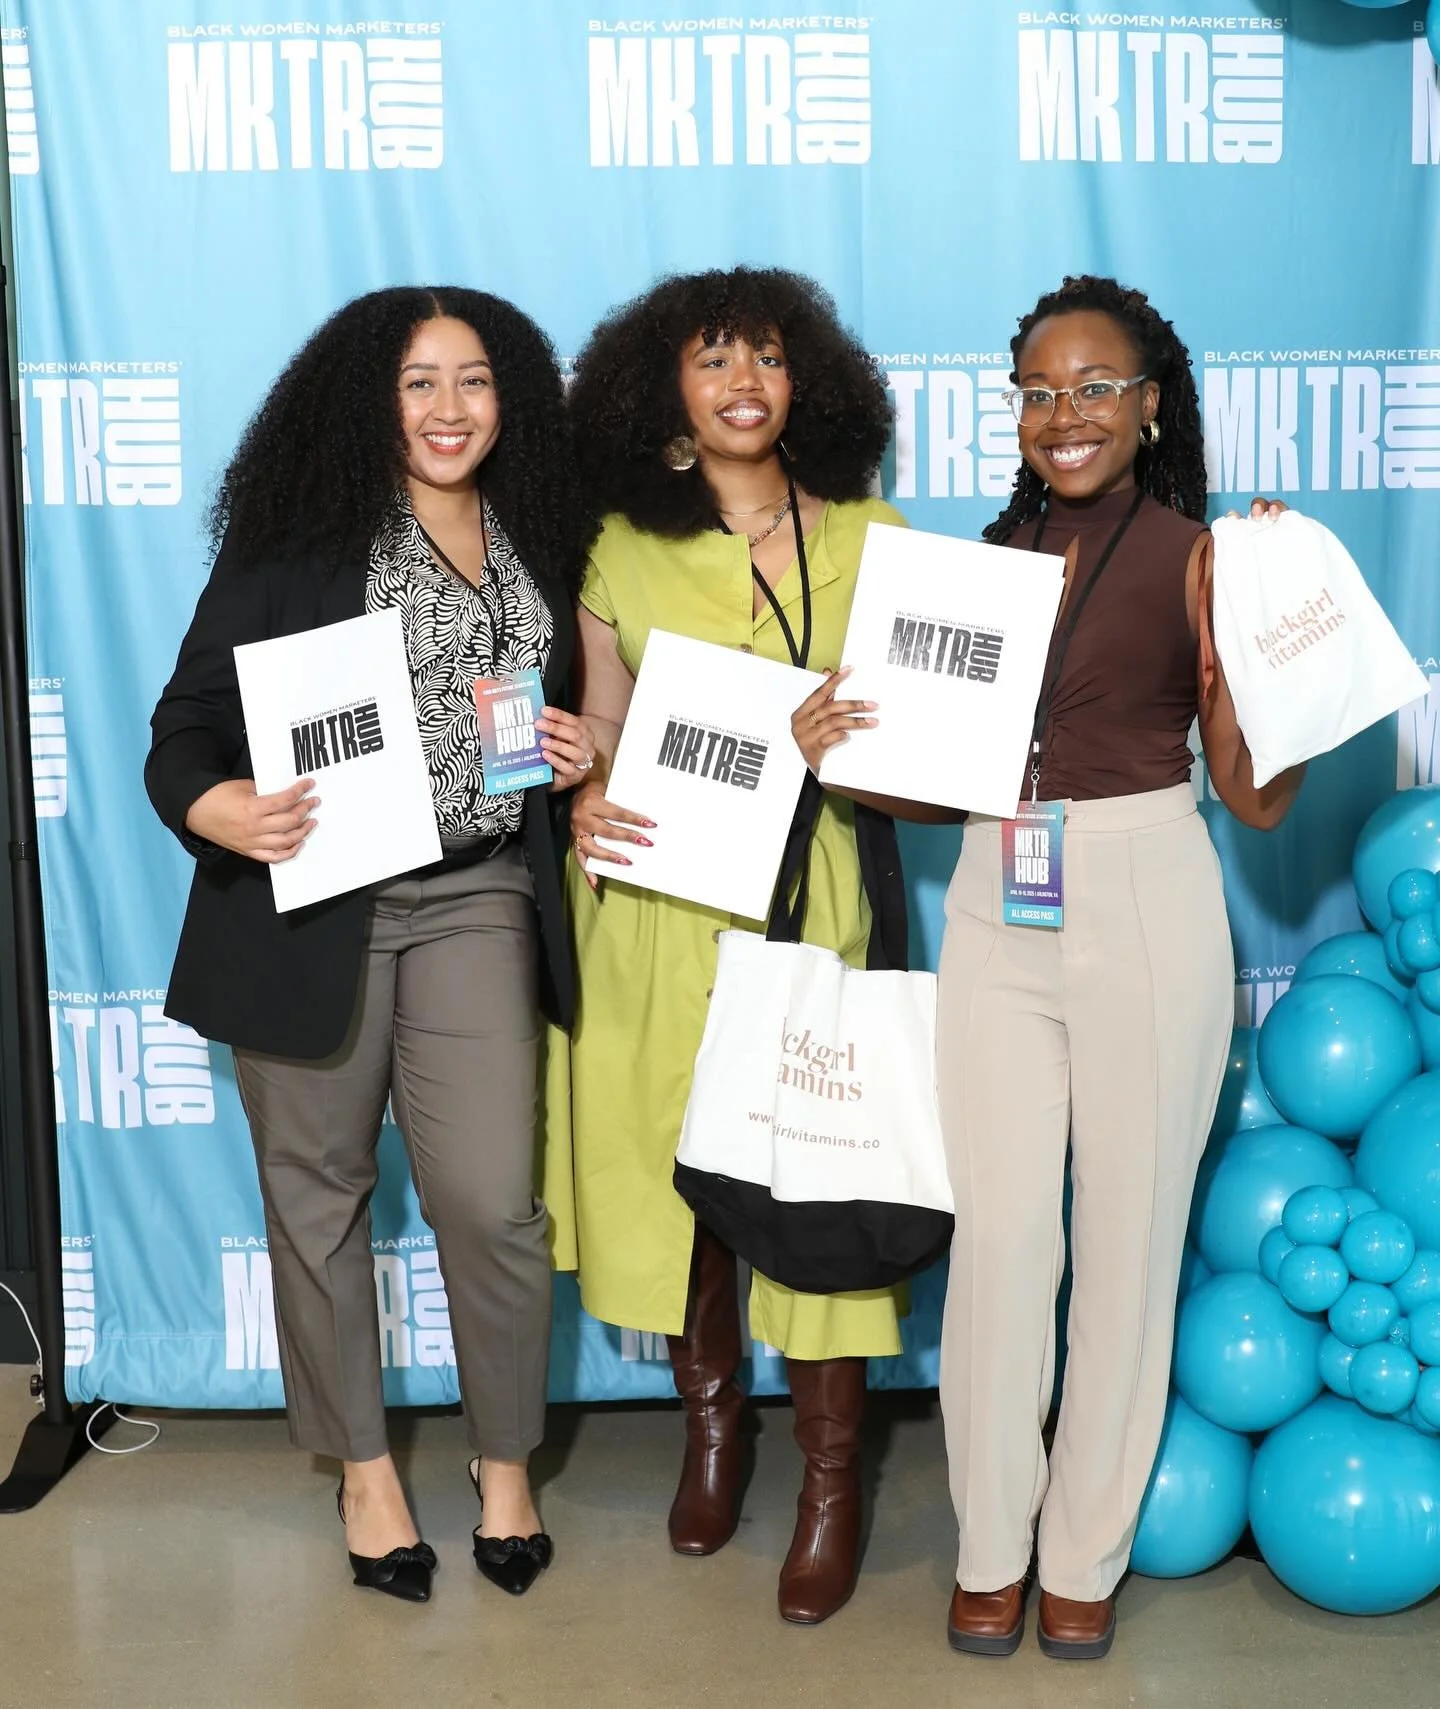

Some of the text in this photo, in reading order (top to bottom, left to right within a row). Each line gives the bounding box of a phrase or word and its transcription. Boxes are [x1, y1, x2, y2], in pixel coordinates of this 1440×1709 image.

[167, 20, 446, 38] BLACK WOMEN MARKETERS'
[588, 16, 874, 32] BLACK WOMEN MARKETERS'
[1018, 12, 1288, 29] BLACK WOMEN MARKETERS'
[167, 39, 370, 172] MKTR
[366, 38, 444, 170] HUB
[588, 34, 792, 167] MKTR
[794, 32, 871, 165] HUB
[1018, 29, 1209, 163] MKTR
[1212, 34, 1284, 164] HUB
[18, 362, 69, 374] OMEN
[869, 352, 1014, 365] OMEN MARKET
[1204, 349, 1440, 362] BLACK WOMEN MARKETER
[18, 379, 103, 505] TR
[102, 378, 182, 506] HUB
[886, 370, 974, 498] TR
[1204, 366, 1381, 493] MKTR
[887, 617, 972, 678] MKTR
[966, 632, 1004, 684] HUB
[353, 702, 384, 755] HUB
[492, 698, 534, 729] MKTR
[291, 711, 359, 776] MKTR
[496, 724, 536, 755] HUB
[657, 720, 738, 783] MKTR
[495, 770, 545, 789] ALL ACCESS PASS
[730, 740, 768, 791] HUB
[1015, 829, 1050, 858] MKTR
[1015, 856, 1050, 885] HUB
[1011, 908, 1054, 921] ALL ACCESS PASS
[48, 989, 166, 1004] OMEN MARKE
[49, 1005, 142, 1128] TR
[777, 1062, 862, 1102] amins
[221, 1236, 269, 1248] BLAC
[371, 1235, 434, 1249] MARKE
